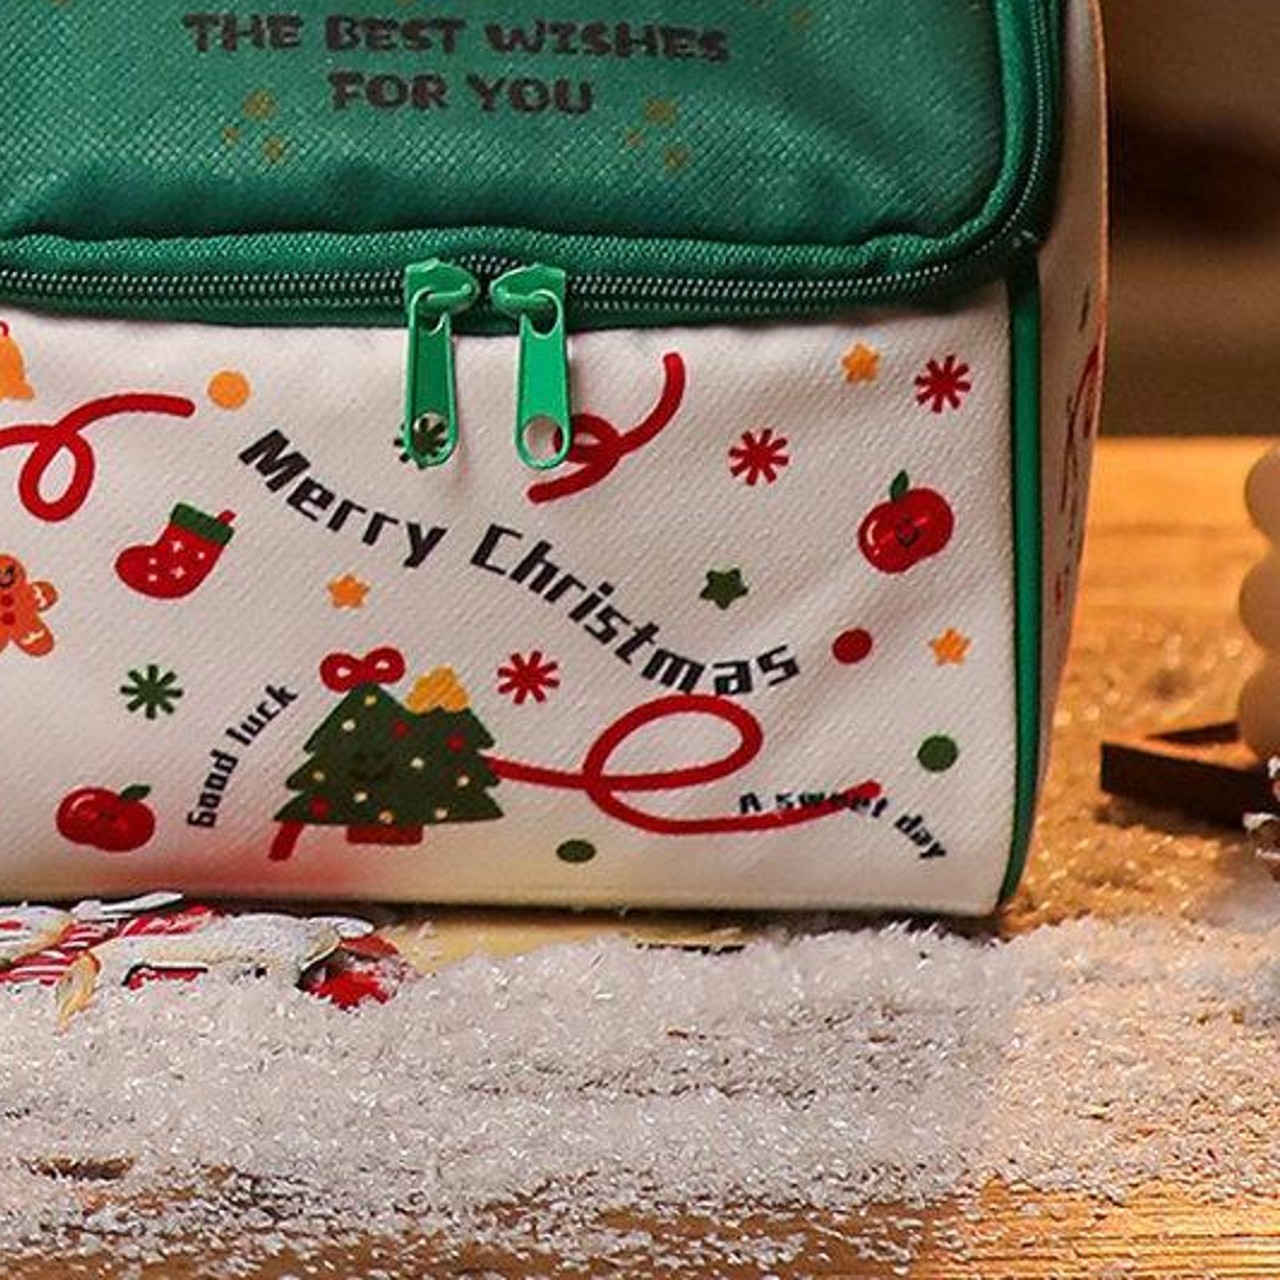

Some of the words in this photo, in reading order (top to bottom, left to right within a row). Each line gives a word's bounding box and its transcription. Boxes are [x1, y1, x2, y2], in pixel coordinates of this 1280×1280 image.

[183, 12, 304, 52] THE
[324, 14, 466, 54] BEST
[483, 20, 731, 64] WISHES
[327, 70, 449, 112] FOR
[466, 74, 594, 116] YOU
[239, 428, 446, 569] Merry
[469, 522, 801, 696] Christmas
[187, 748, 240, 828] Good
[225, 684, 299, 746] luck
[893, 814, 947, 860] day
